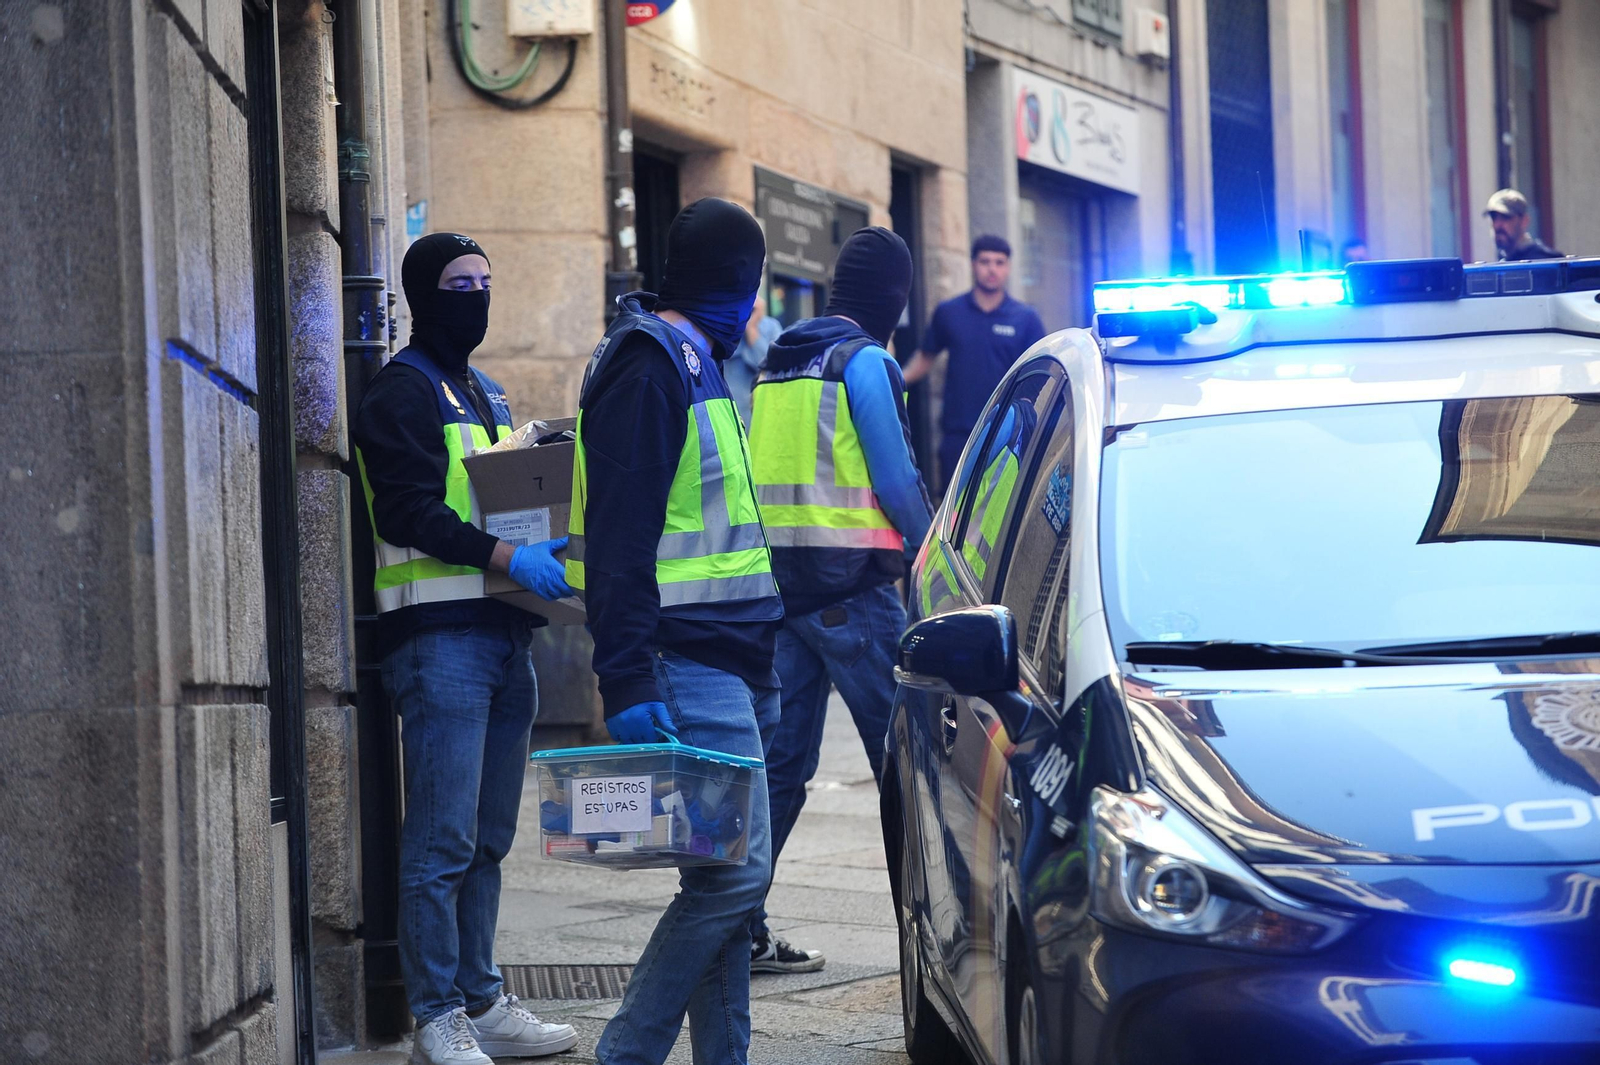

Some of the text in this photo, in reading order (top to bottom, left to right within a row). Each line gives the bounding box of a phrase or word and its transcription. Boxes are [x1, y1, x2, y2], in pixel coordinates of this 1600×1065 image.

[581, 780, 647, 796] REGISTROS
[584, 800, 639, 815] ESTUPAS
[1410, 796, 1600, 842] PO
